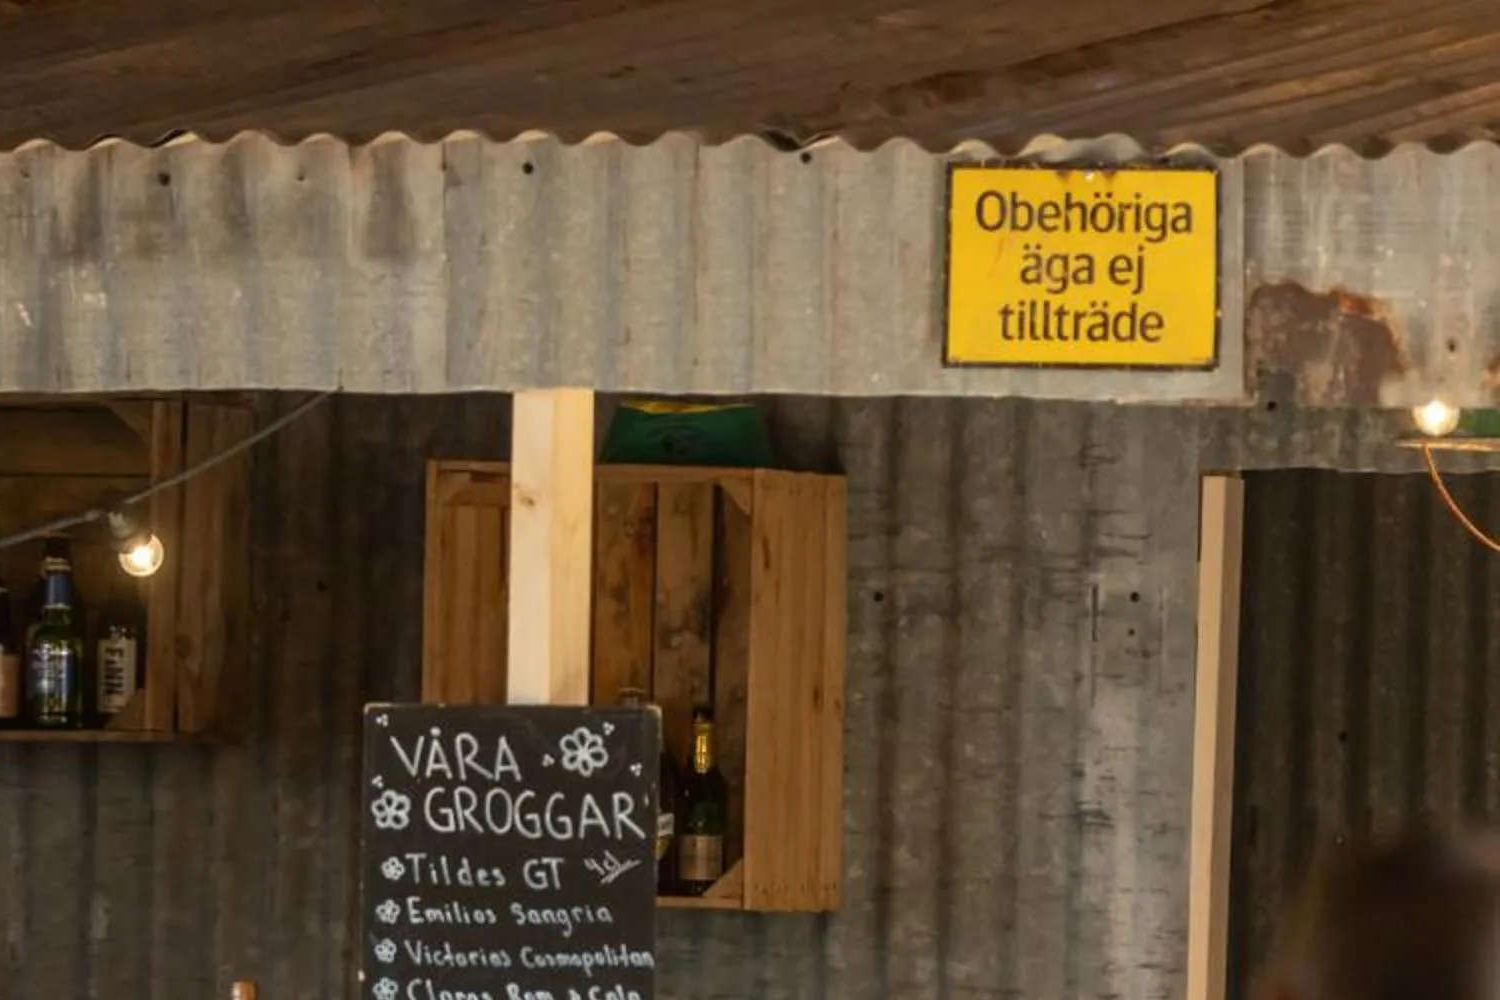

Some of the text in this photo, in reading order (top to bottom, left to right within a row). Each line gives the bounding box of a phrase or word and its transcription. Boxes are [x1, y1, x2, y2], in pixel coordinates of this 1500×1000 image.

[975, 190, 1194, 244] Obehöriga
[1019, 243, 1146, 295] äga ej
[998, 300, 1166, 343] tillträde
[389, 726, 522, 782] VÅRA
[424, 786, 647, 841] GROGGAR
[404, 853, 507, 888] Tildes
[523, 857, 565, 890] GT
[405, 896, 614, 938] Emilias Sangria
[403, 939, 512, 968] Victorias
